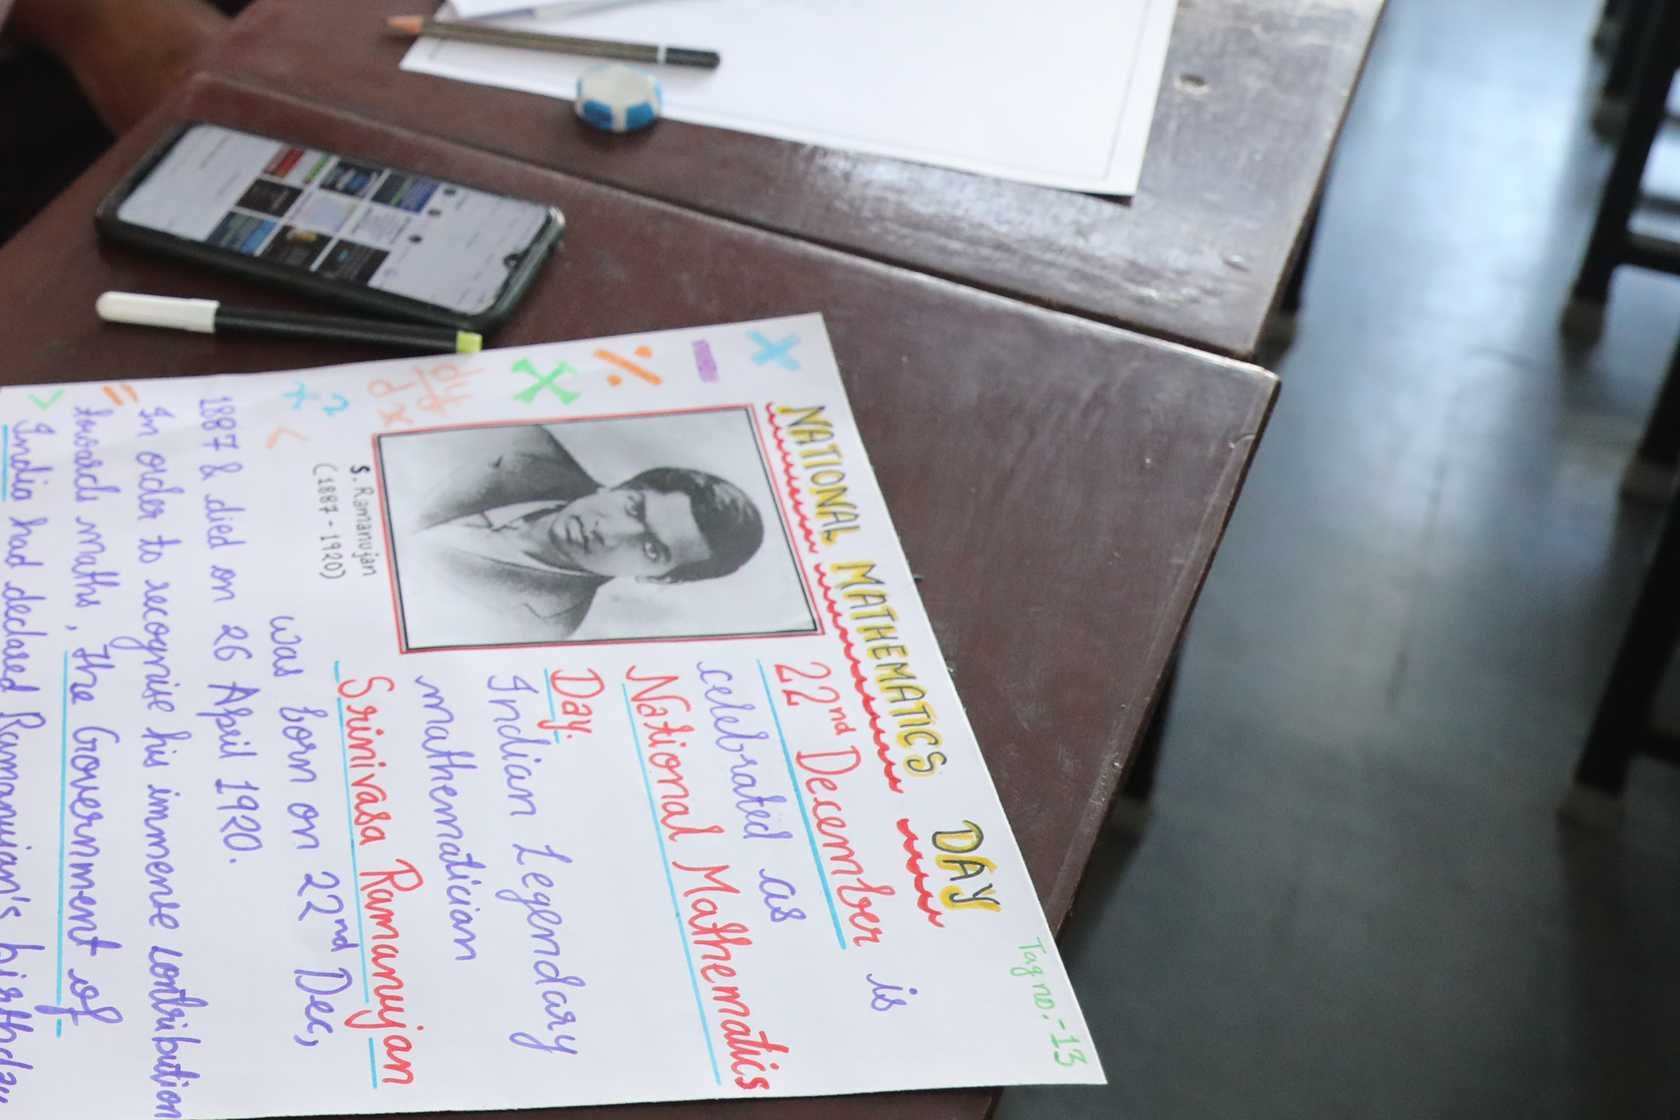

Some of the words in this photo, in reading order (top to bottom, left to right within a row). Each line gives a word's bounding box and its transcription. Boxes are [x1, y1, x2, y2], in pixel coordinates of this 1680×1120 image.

[9, 420, 56, 503] India
[72, 406, 122, 504] towards
[137, 406, 175, 437] In
[199, 396, 238, 452] 1887
[135, 451, 185, 520] order
[199, 462, 243, 482] &
[4, 517, 48, 569] had
[138, 533, 182, 564] to
[204, 494, 246, 550] died
[351, 486, 378, 578] Ramanujan
[210, 565, 236, 603] on
[108, 579, 180, 713] recognise
[213, 623, 253, 662] 26
[270, 615, 304, 678] was
[776, 403, 861, 546] NATIONAL
[827, 560, 948, 777] MATHEMATICS
[931, 820, 1003, 912] DAY
[140, 727, 193, 768] his
[195, 681, 261, 760] April
[278, 706, 329, 784] born
[336, 676, 396, 846] Srinivasa
[487, 674, 554, 817] Indian
[625, 664, 725, 842] National
[287, 802, 321, 850] on
[415, 674, 487, 961] mathematician
[696, 661, 793, 840] celebrated
[758, 868, 807, 923] as
[66, 726, 123, 957] Government
[143, 784, 181, 931] immense
[796, 746, 895, 947] December
[866, 973, 918, 1012] is
[344, 858, 424, 1086] Ramanujan
[495, 843, 587, 1055] Legendary
[672, 860, 790, 1090] Mathematics
[1010, 936, 1047, 978] Tag
[34, 968, 123, 1025] of
[147, 944, 209, 1119] contribution
